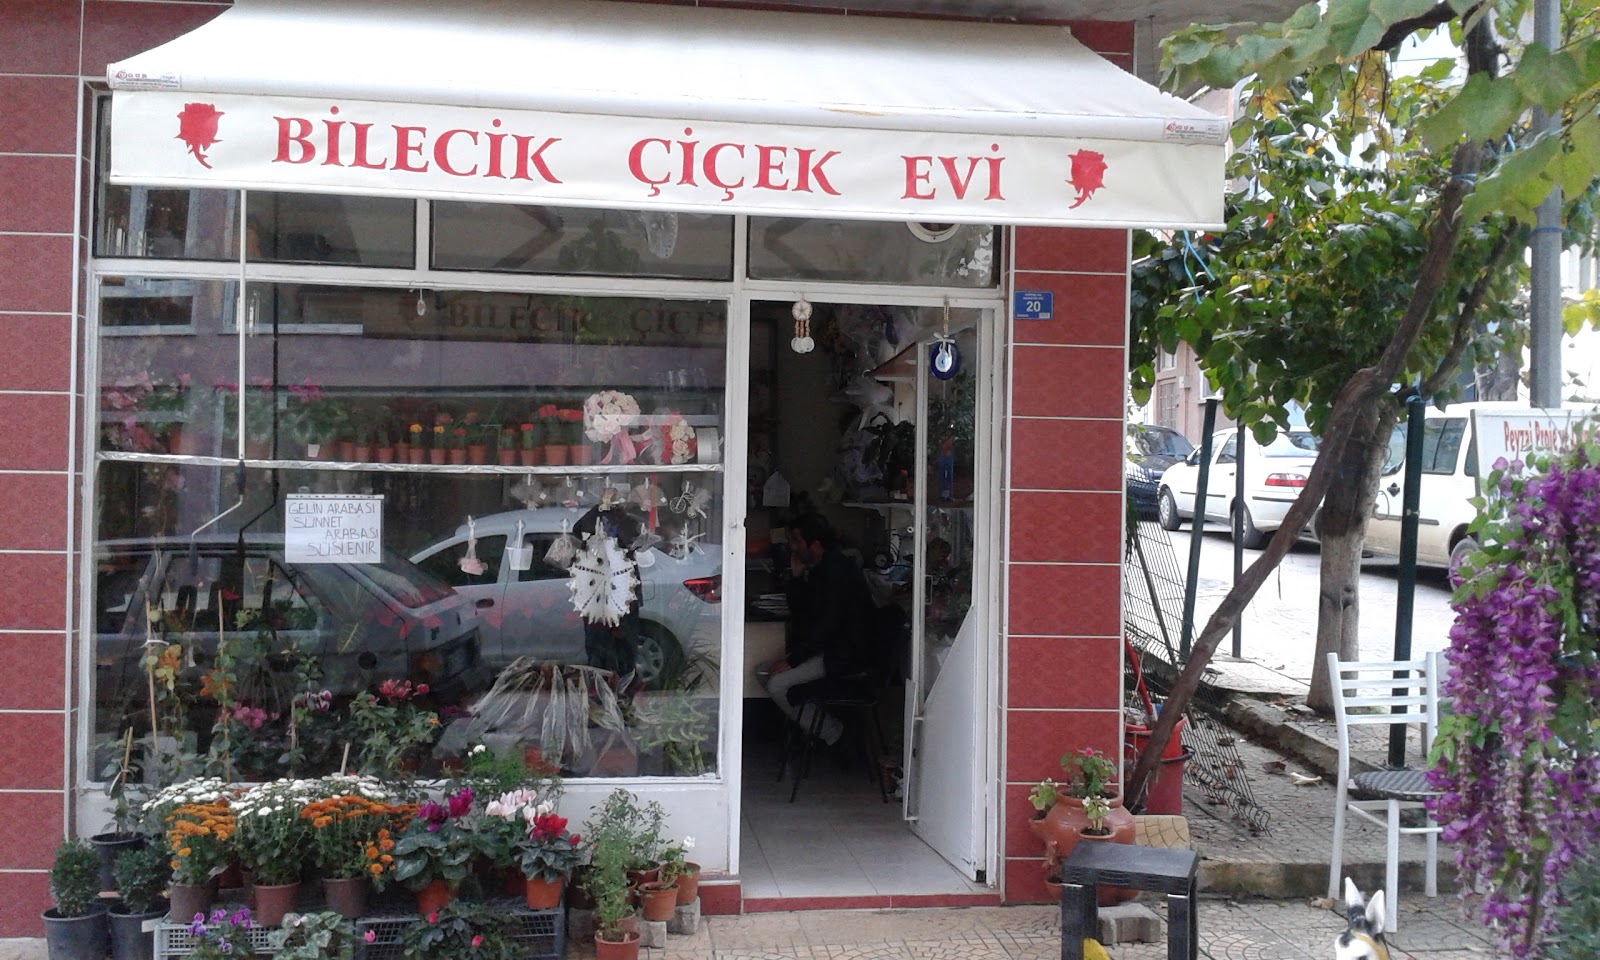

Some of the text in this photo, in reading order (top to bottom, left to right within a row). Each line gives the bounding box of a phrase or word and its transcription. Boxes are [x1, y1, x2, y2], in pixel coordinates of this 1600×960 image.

[272, 106, 1006, 202] BİLECİK ÇİÇEK EVİ
[1026, 300, 1041, 312] 20
[327, 502, 375, 514] ARABASI
[326, 528, 378, 540] ARABASI
